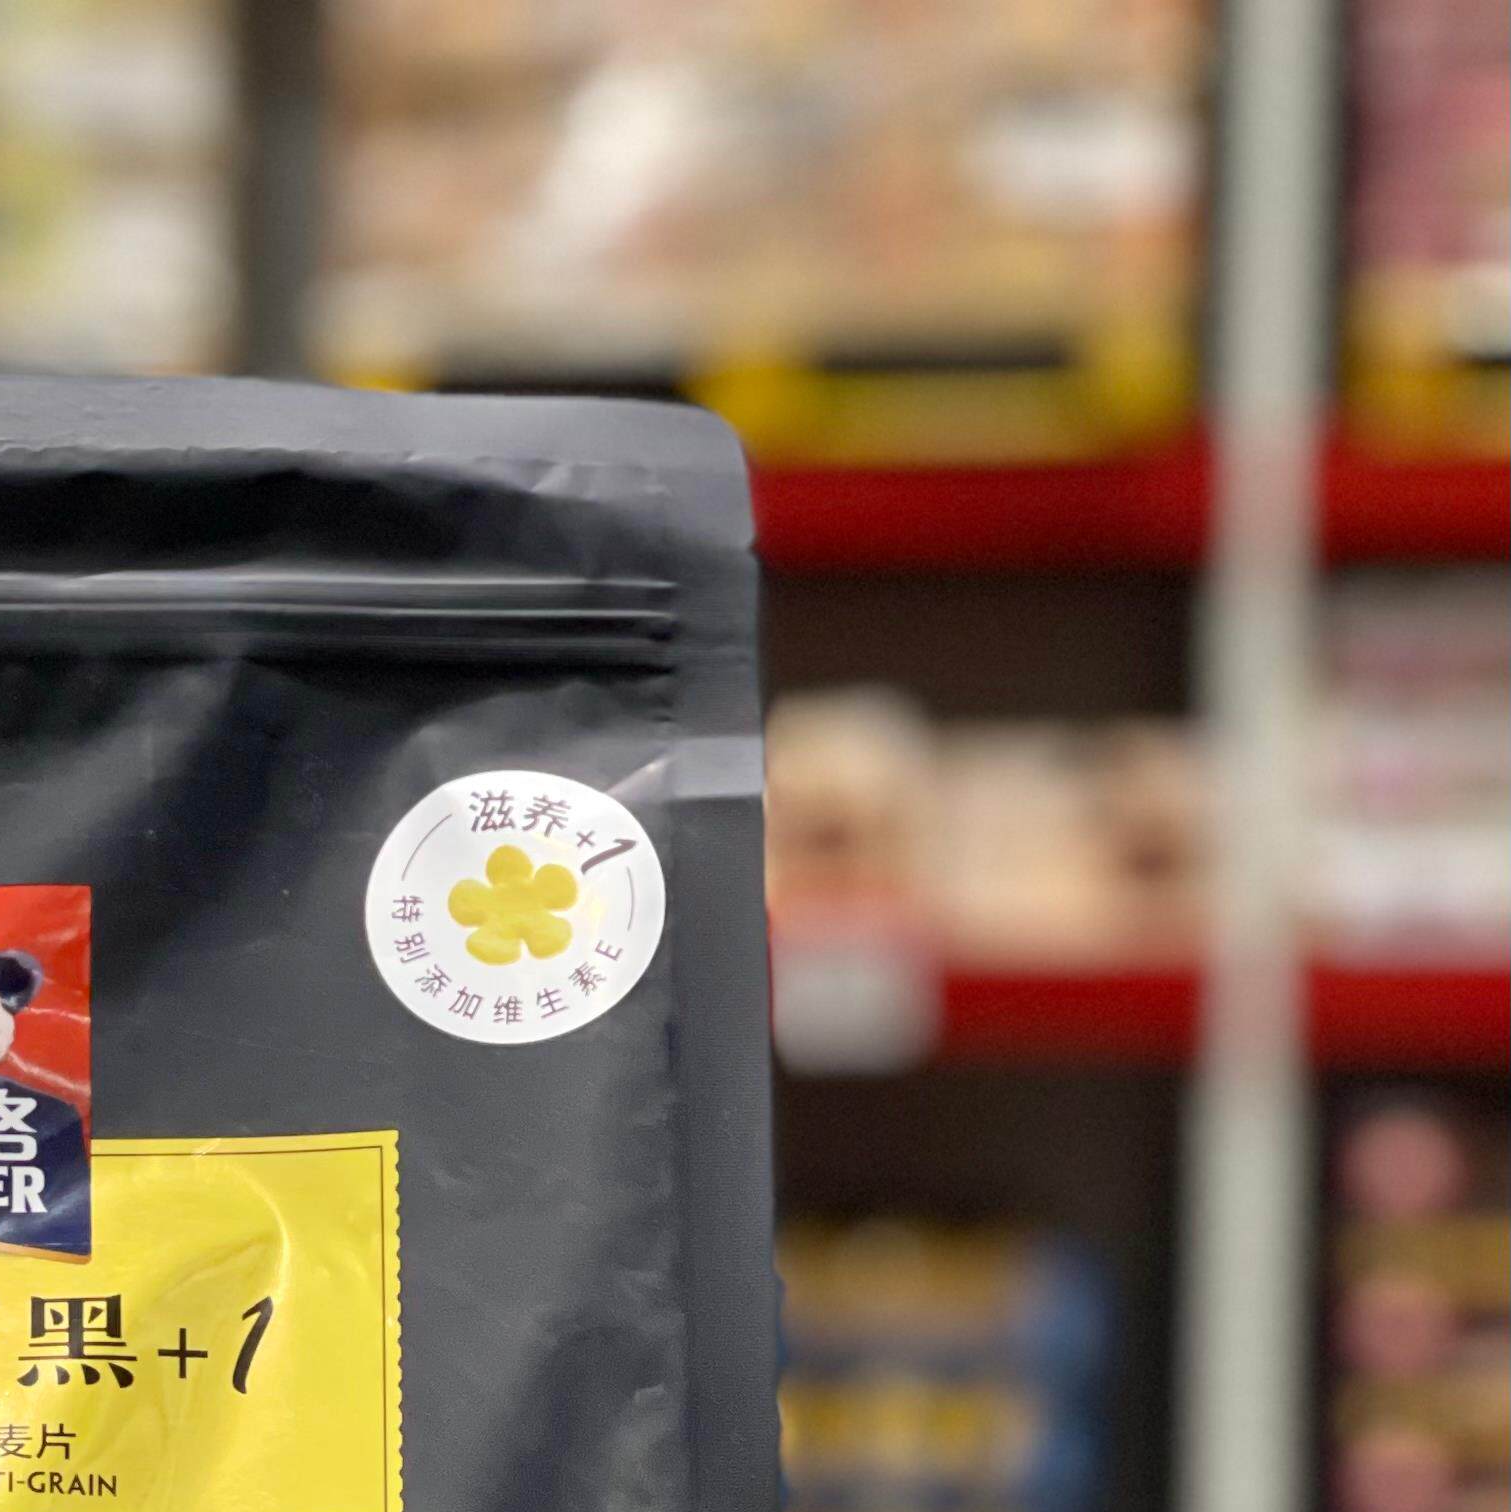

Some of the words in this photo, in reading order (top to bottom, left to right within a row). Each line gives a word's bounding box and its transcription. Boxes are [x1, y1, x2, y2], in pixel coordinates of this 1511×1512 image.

[469, 790, 637, 875] 滋养+1
[392, 896, 623, 1024] 特别添加维生素E
